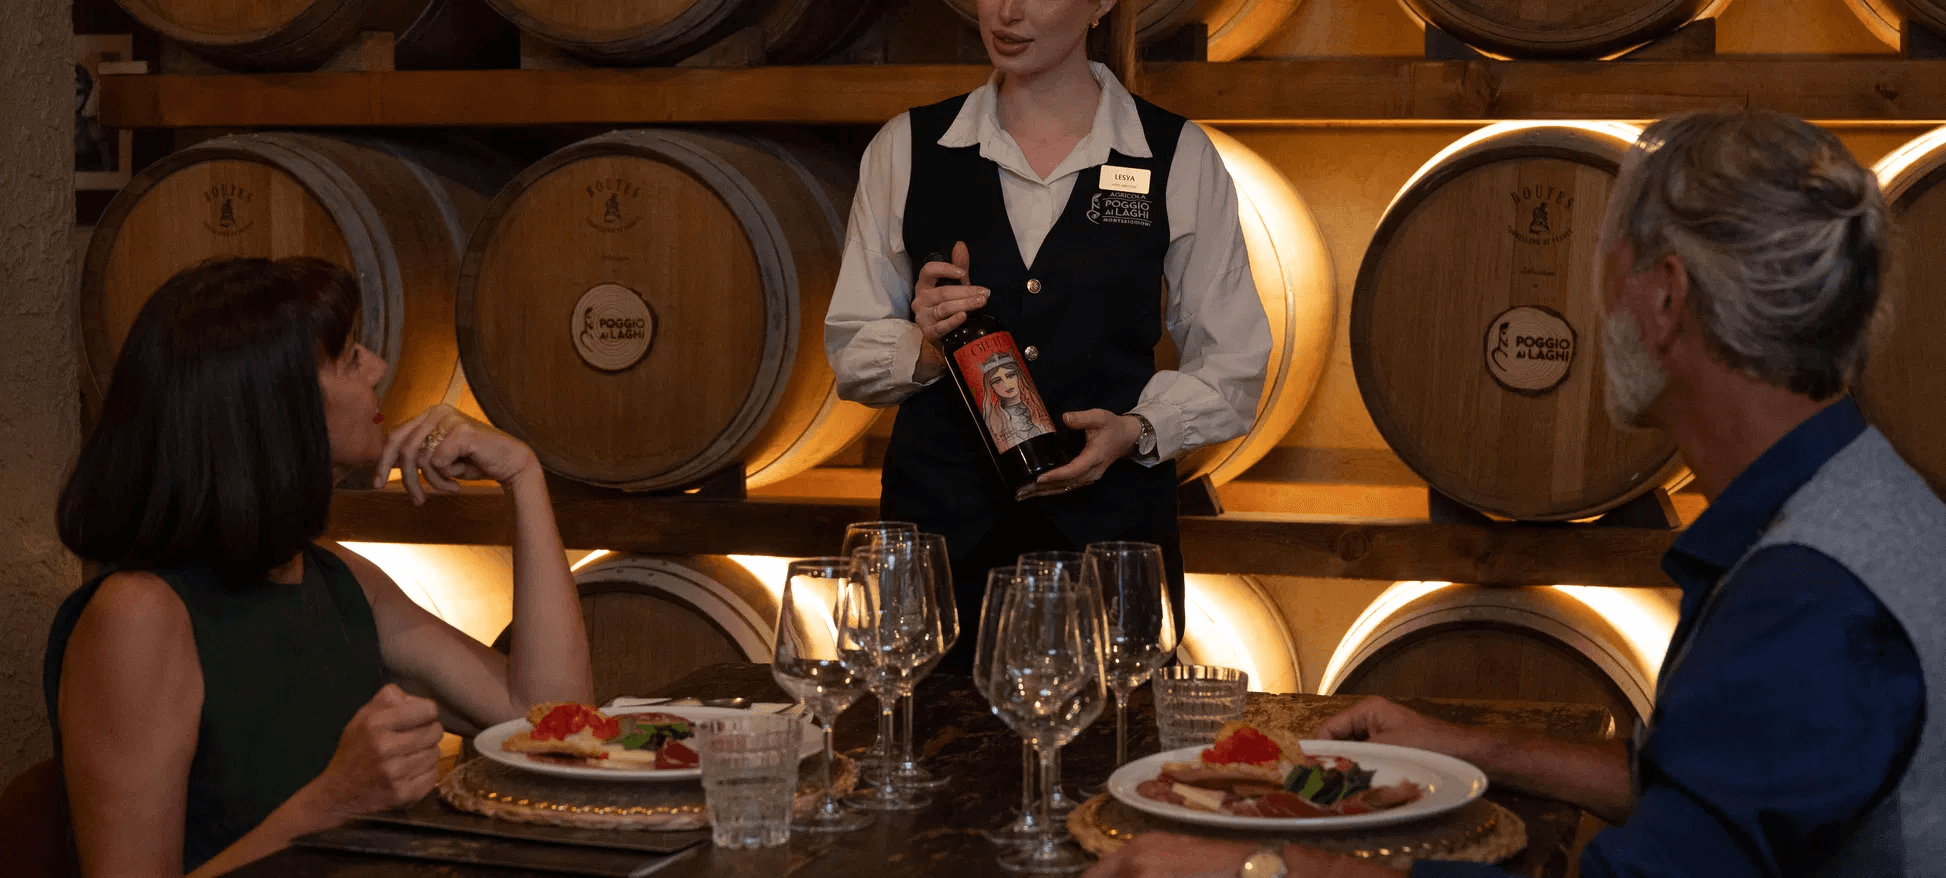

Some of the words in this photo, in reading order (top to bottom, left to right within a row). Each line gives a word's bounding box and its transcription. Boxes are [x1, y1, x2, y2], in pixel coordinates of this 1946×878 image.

[1114, 173, 1136, 182] LESYA
[1109, 192, 1146, 200] AGRICOLA
[1510, 184, 1574, 209] BOUTES
[1105, 200, 1150, 211] POGGIO
[1115, 208, 1149, 219] LAGHI
[599, 319, 645, 329] POGGIO
[610, 329, 645, 339] LAGHI
[1516, 336, 1570, 350] POGGIO
[1528, 348, 1569, 362] LAGHI
